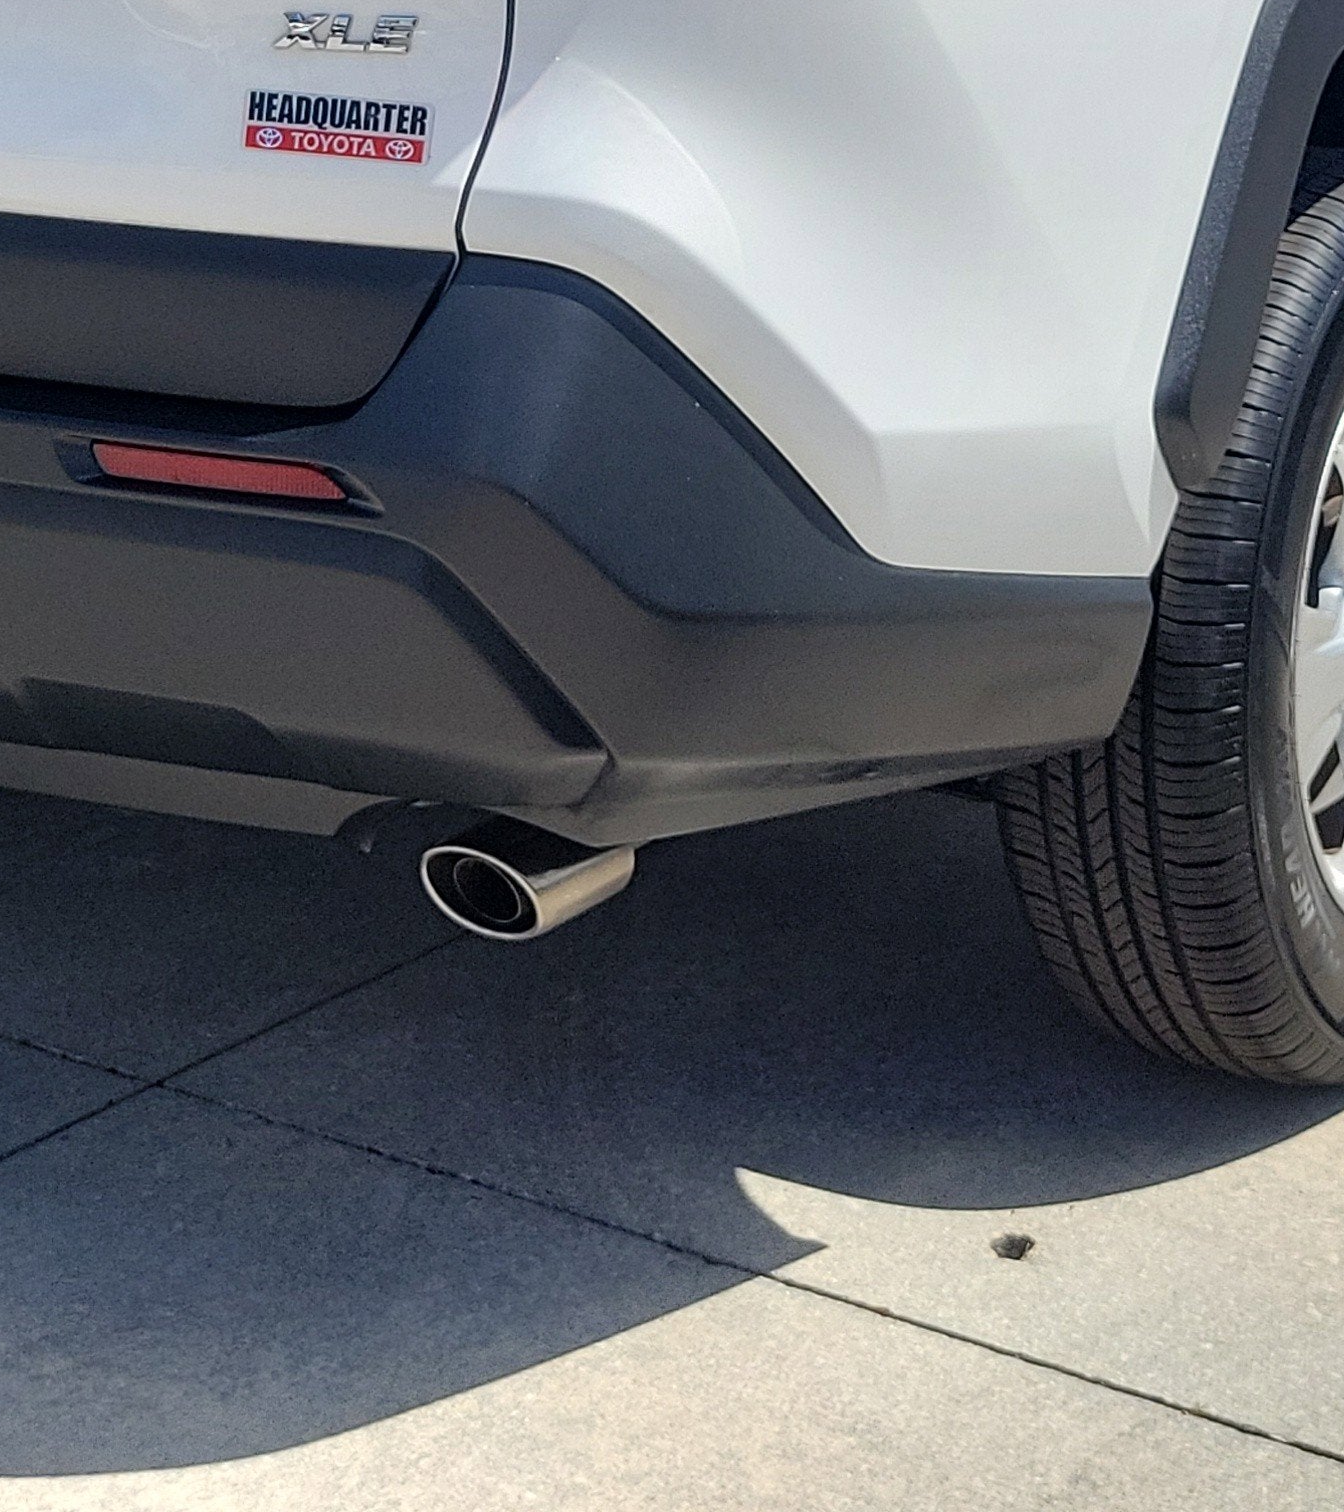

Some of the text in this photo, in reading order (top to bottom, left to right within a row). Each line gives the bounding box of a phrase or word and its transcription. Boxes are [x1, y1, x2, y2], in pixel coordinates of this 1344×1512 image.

[273, 11, 419, 55] XLE
[248, 91, 429, 136] HEADQUARTER
[290, 132, 378, 157] TOYOTA
